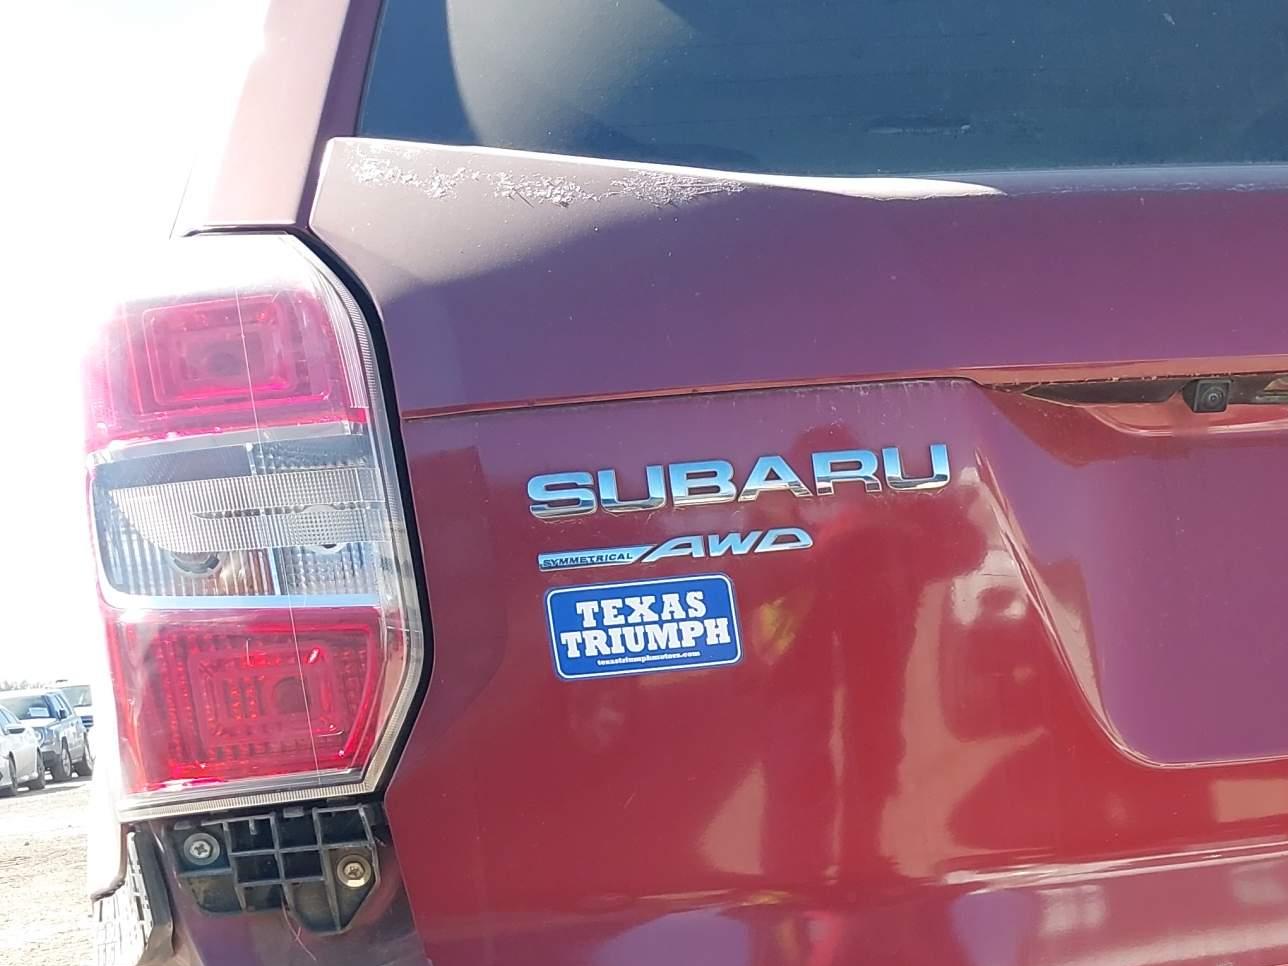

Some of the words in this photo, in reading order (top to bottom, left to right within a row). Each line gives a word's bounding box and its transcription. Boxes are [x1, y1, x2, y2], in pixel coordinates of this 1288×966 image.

[527, 443, 951, 519] SUBARU
[541, 552, 633, 568] SYMMETRICAL
[641, 527, 813, 563] AWD
[576, 591, 707, 628] TEXAS
[560, 617, 731, 658] TRIUMPH
